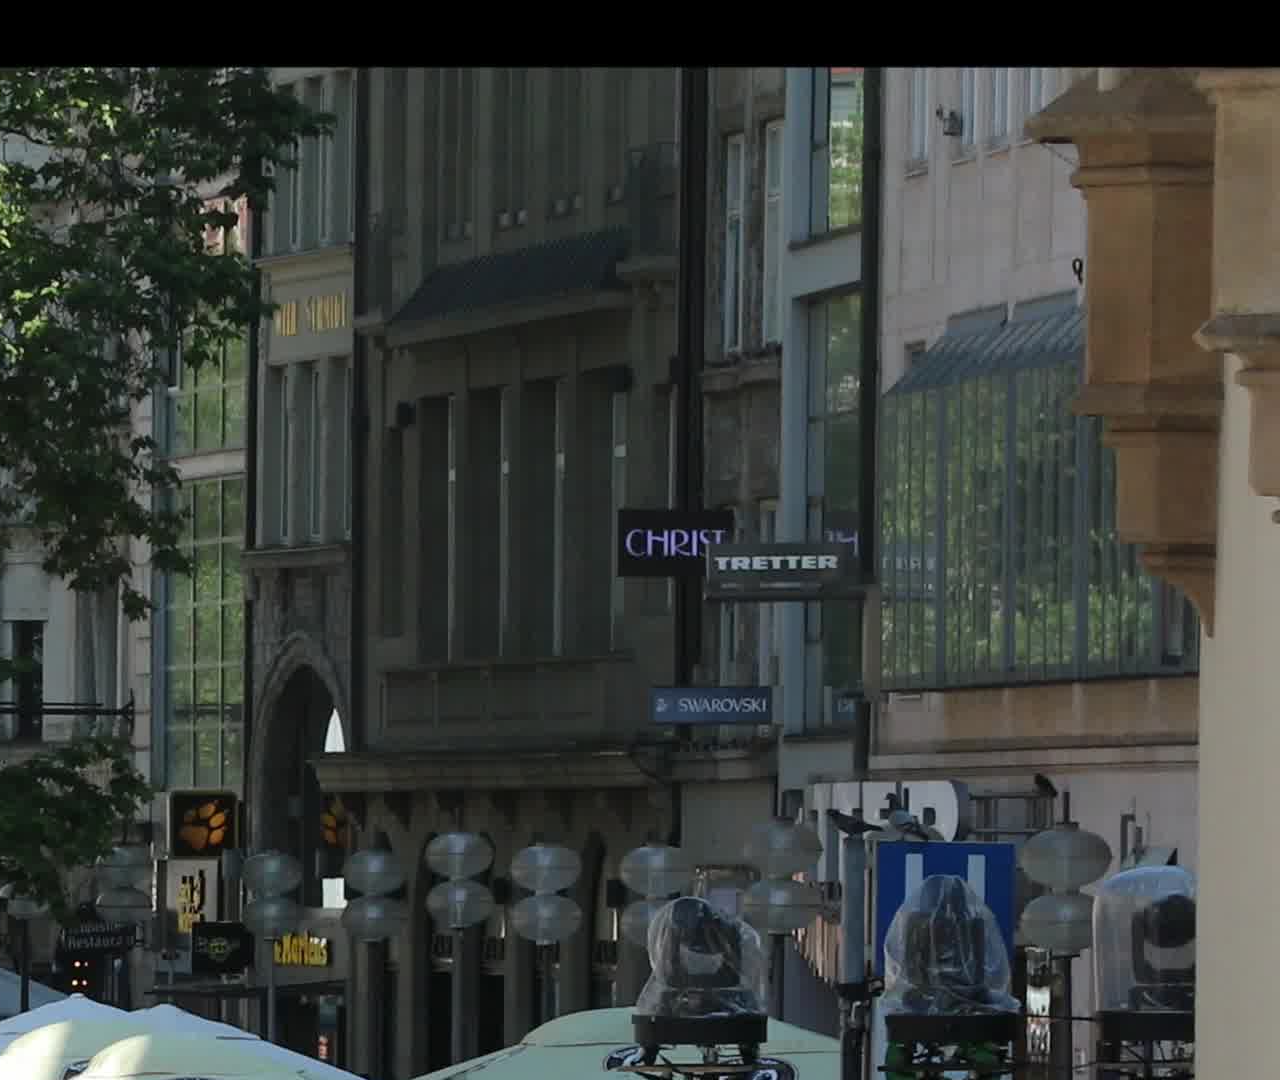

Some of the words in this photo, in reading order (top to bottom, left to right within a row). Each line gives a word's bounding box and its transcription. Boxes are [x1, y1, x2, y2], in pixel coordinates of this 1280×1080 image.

[625, 529, 726, 557] CHRIST
[714, 555, 838, 571] TRETTER
[678, 697, 767, 713] SWAROVSKI
